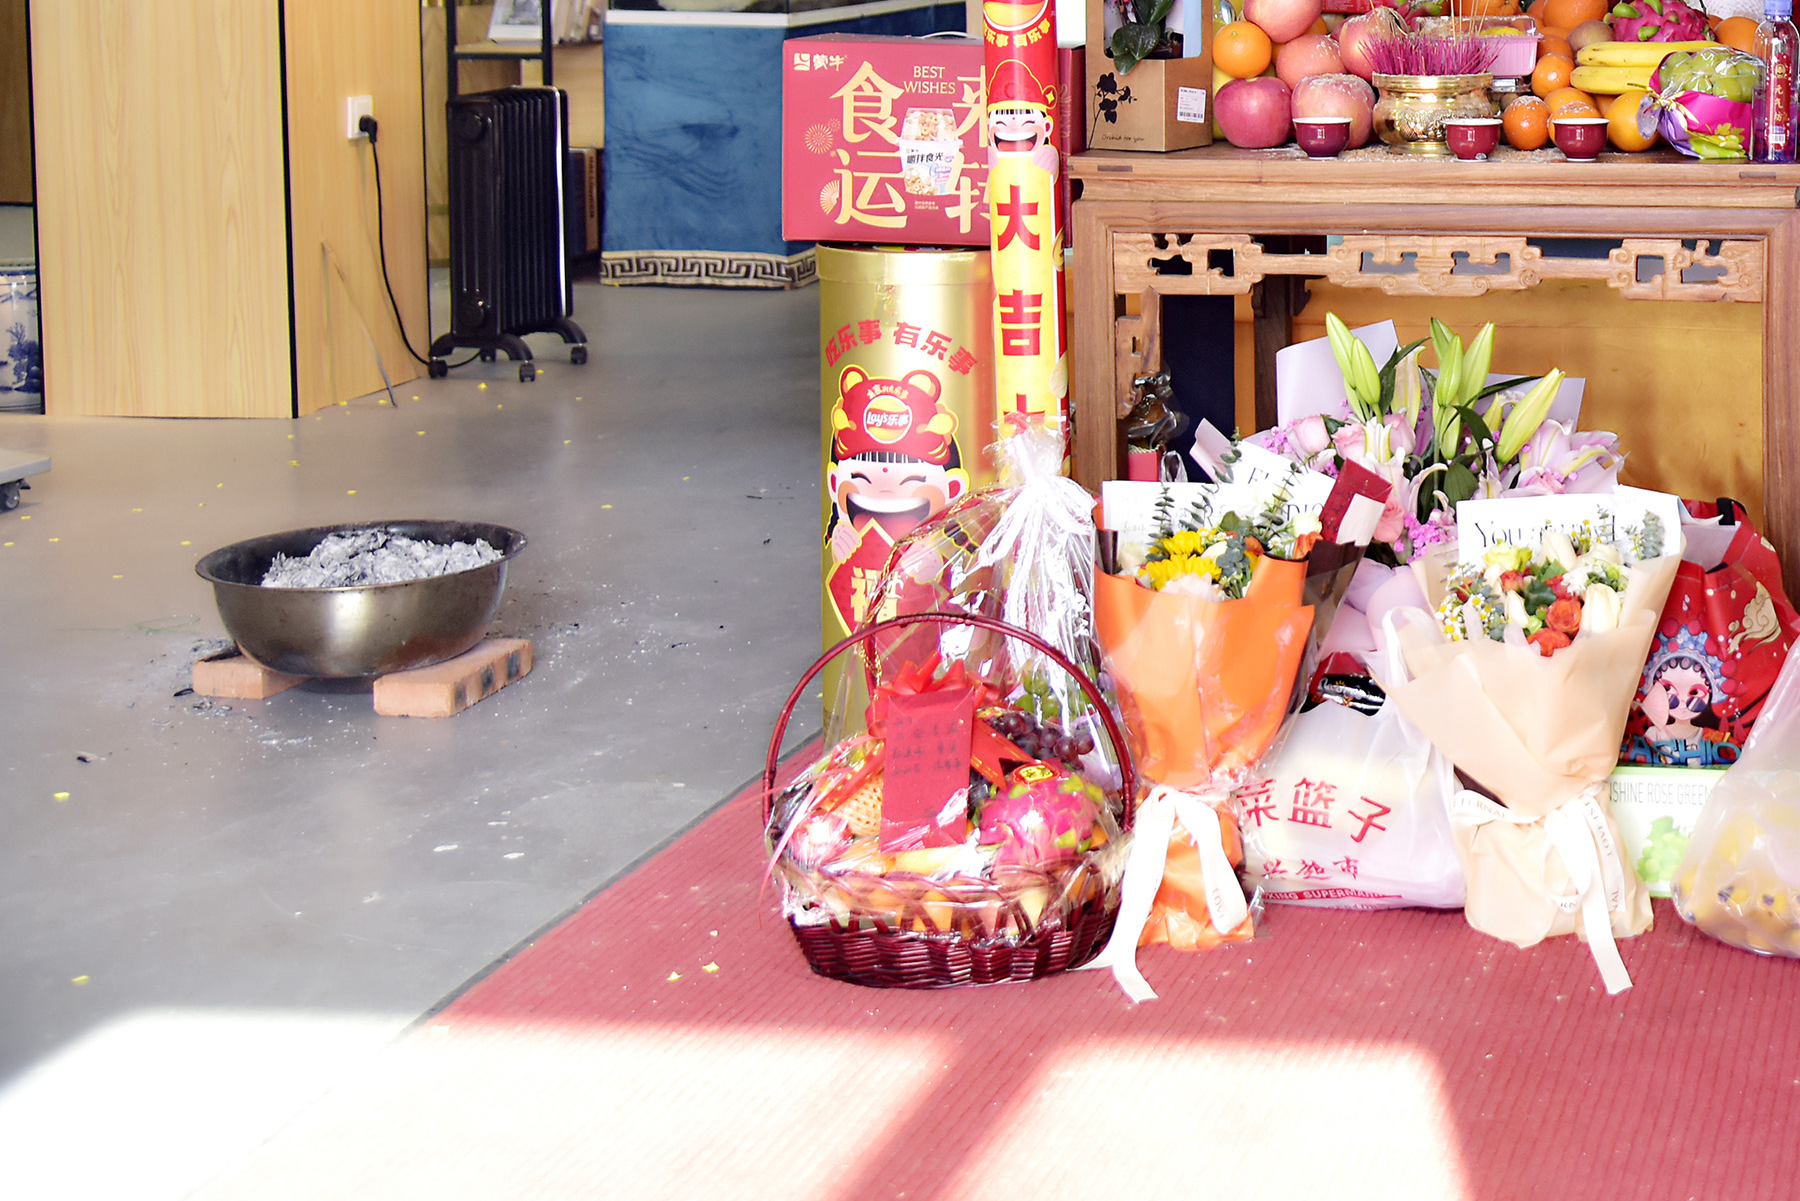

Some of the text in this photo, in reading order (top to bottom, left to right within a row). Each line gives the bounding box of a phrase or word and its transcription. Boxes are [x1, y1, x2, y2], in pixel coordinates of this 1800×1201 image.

[812, 53, 845, 72] 蒙牛
[912, 65, 945, 79] BEST
[903, 80, 957, 95] WISHES
[892, 321, 978, 377] 有乐事
[1620, 734, 1744, 766] ASHIO
[1646, 782, 1674, 805] ROSE
[1236, 777, 1392, 843] 菜篮子
